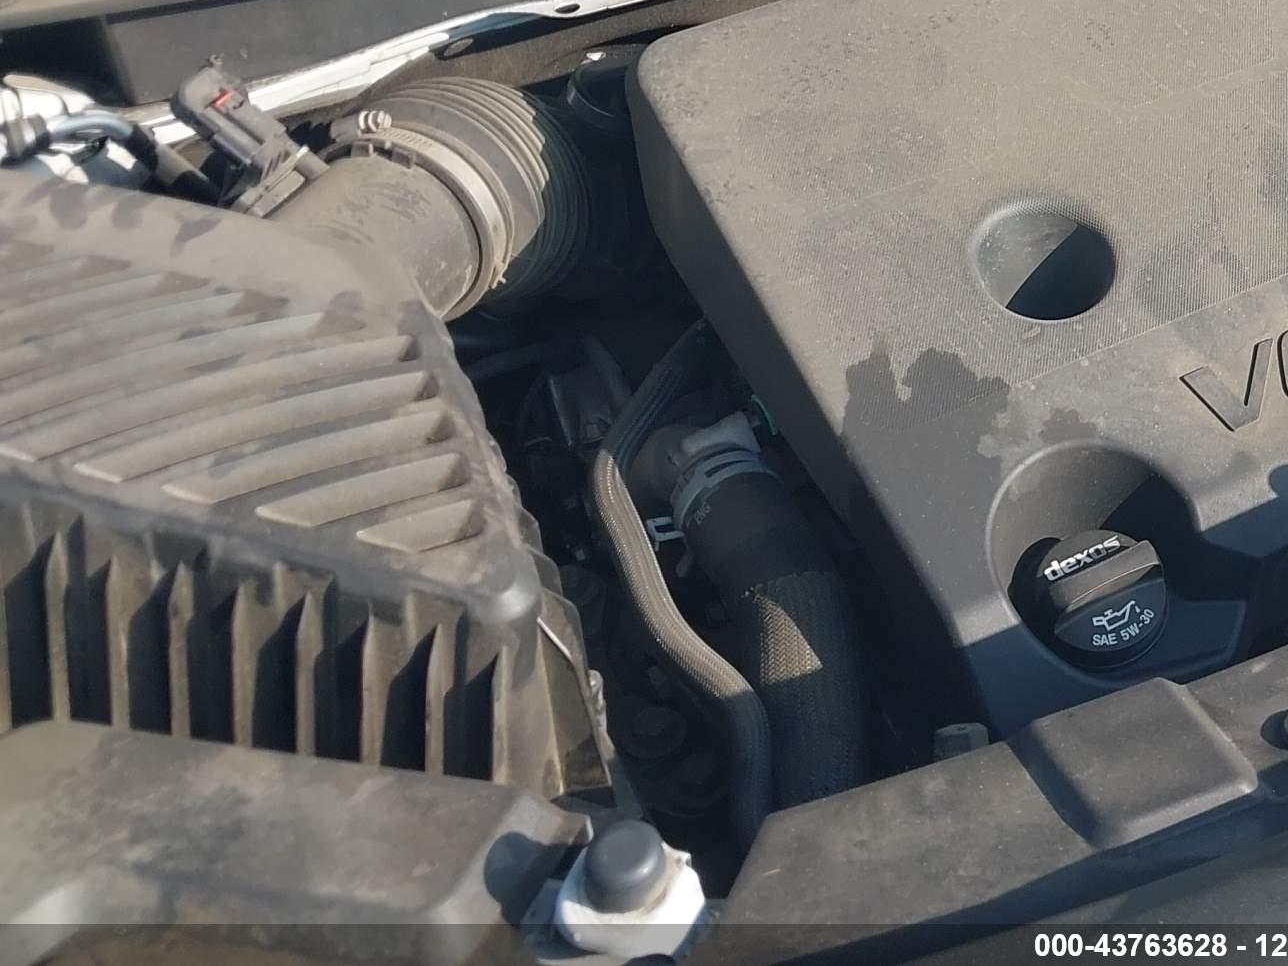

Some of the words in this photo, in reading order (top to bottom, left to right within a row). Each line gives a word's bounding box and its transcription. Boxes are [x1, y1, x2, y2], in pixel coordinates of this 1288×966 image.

[1043, 534, 1121, 582] dexos
[1092, 632, 1118, 647] SAE
[1120, 608, 1155, 642] 5W-30
